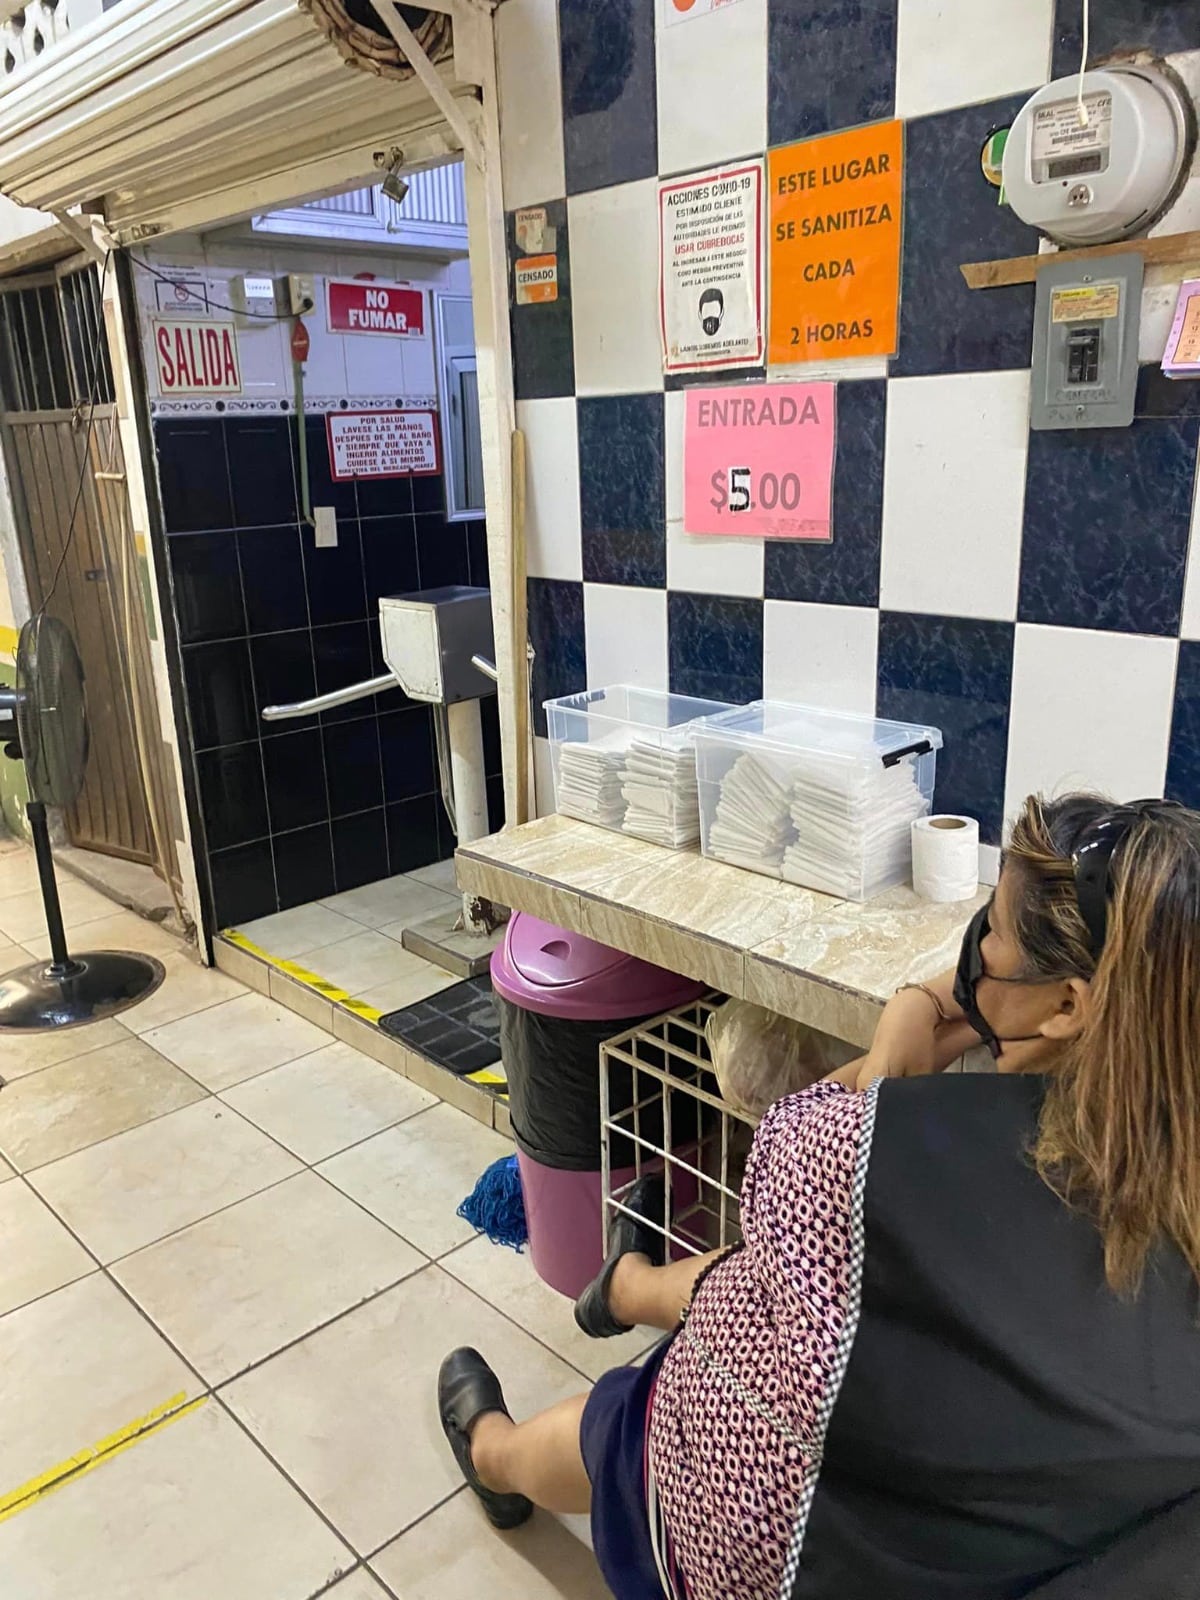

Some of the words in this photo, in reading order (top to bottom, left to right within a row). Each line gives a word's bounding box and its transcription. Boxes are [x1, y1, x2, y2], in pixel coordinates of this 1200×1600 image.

[778, 169, 816, 196] ESTE
[822, 153, 890, 186] LUGAR
[667, 187, 710, 206] ACCIONES
[711, 177, 751, 197] COVID-19
[714, 196, 743, 210] CLIENTE
[675, 222, 688, 231] POR
[733, 210, 743, 218] LAS
[775, 221, 796, 242] SE
[801, 203, 892, 238] SANITIZA
[674, 242, 695, 255] USAR
[696, 233, 745, 251] CUBREBOCAS
[518, 269, 553, 283] CENSADO
[712, 261, 744, 272] PREVENTIVA
[803, 258, 856, 283] CADA
[702, 272, 741, 284] CONTINGENCIA
[365, 289, 390, 309] NO
[348, 308, 408, 331] FUMAR
[790, 327, 800, 345] 2
[806, 319, 874, 344] HORAS
[157, 326, 238, 387] SALIDA
[360, 417, 377, 425] POR
[380, 416, 406, 424] SALUD
[698, 395, 820, 427] ENTRADA
[334, 434, 371, 443] DESPUES
[374, 433, 384, 441] DE
[387, 432, 396, 440] IR
[342, 425, 373, 434] LAVESE
[376, 424, 391, 432] LAS
[394, 423, 423, 431] MANOS
[345, 442, 381, 451] SIEMPRE
[384, 441, 400, 449] QUE
[403, 440, 423, 448] VAYA
[346, 451, 378, 459] INGERIR
[381, 448, 425, 457] ALIMENTOS
[346, 459, 377, 468] CUIDESE
[400, 456, 426, 464] MISMO
[710, 467, 801, 514] $5.00
